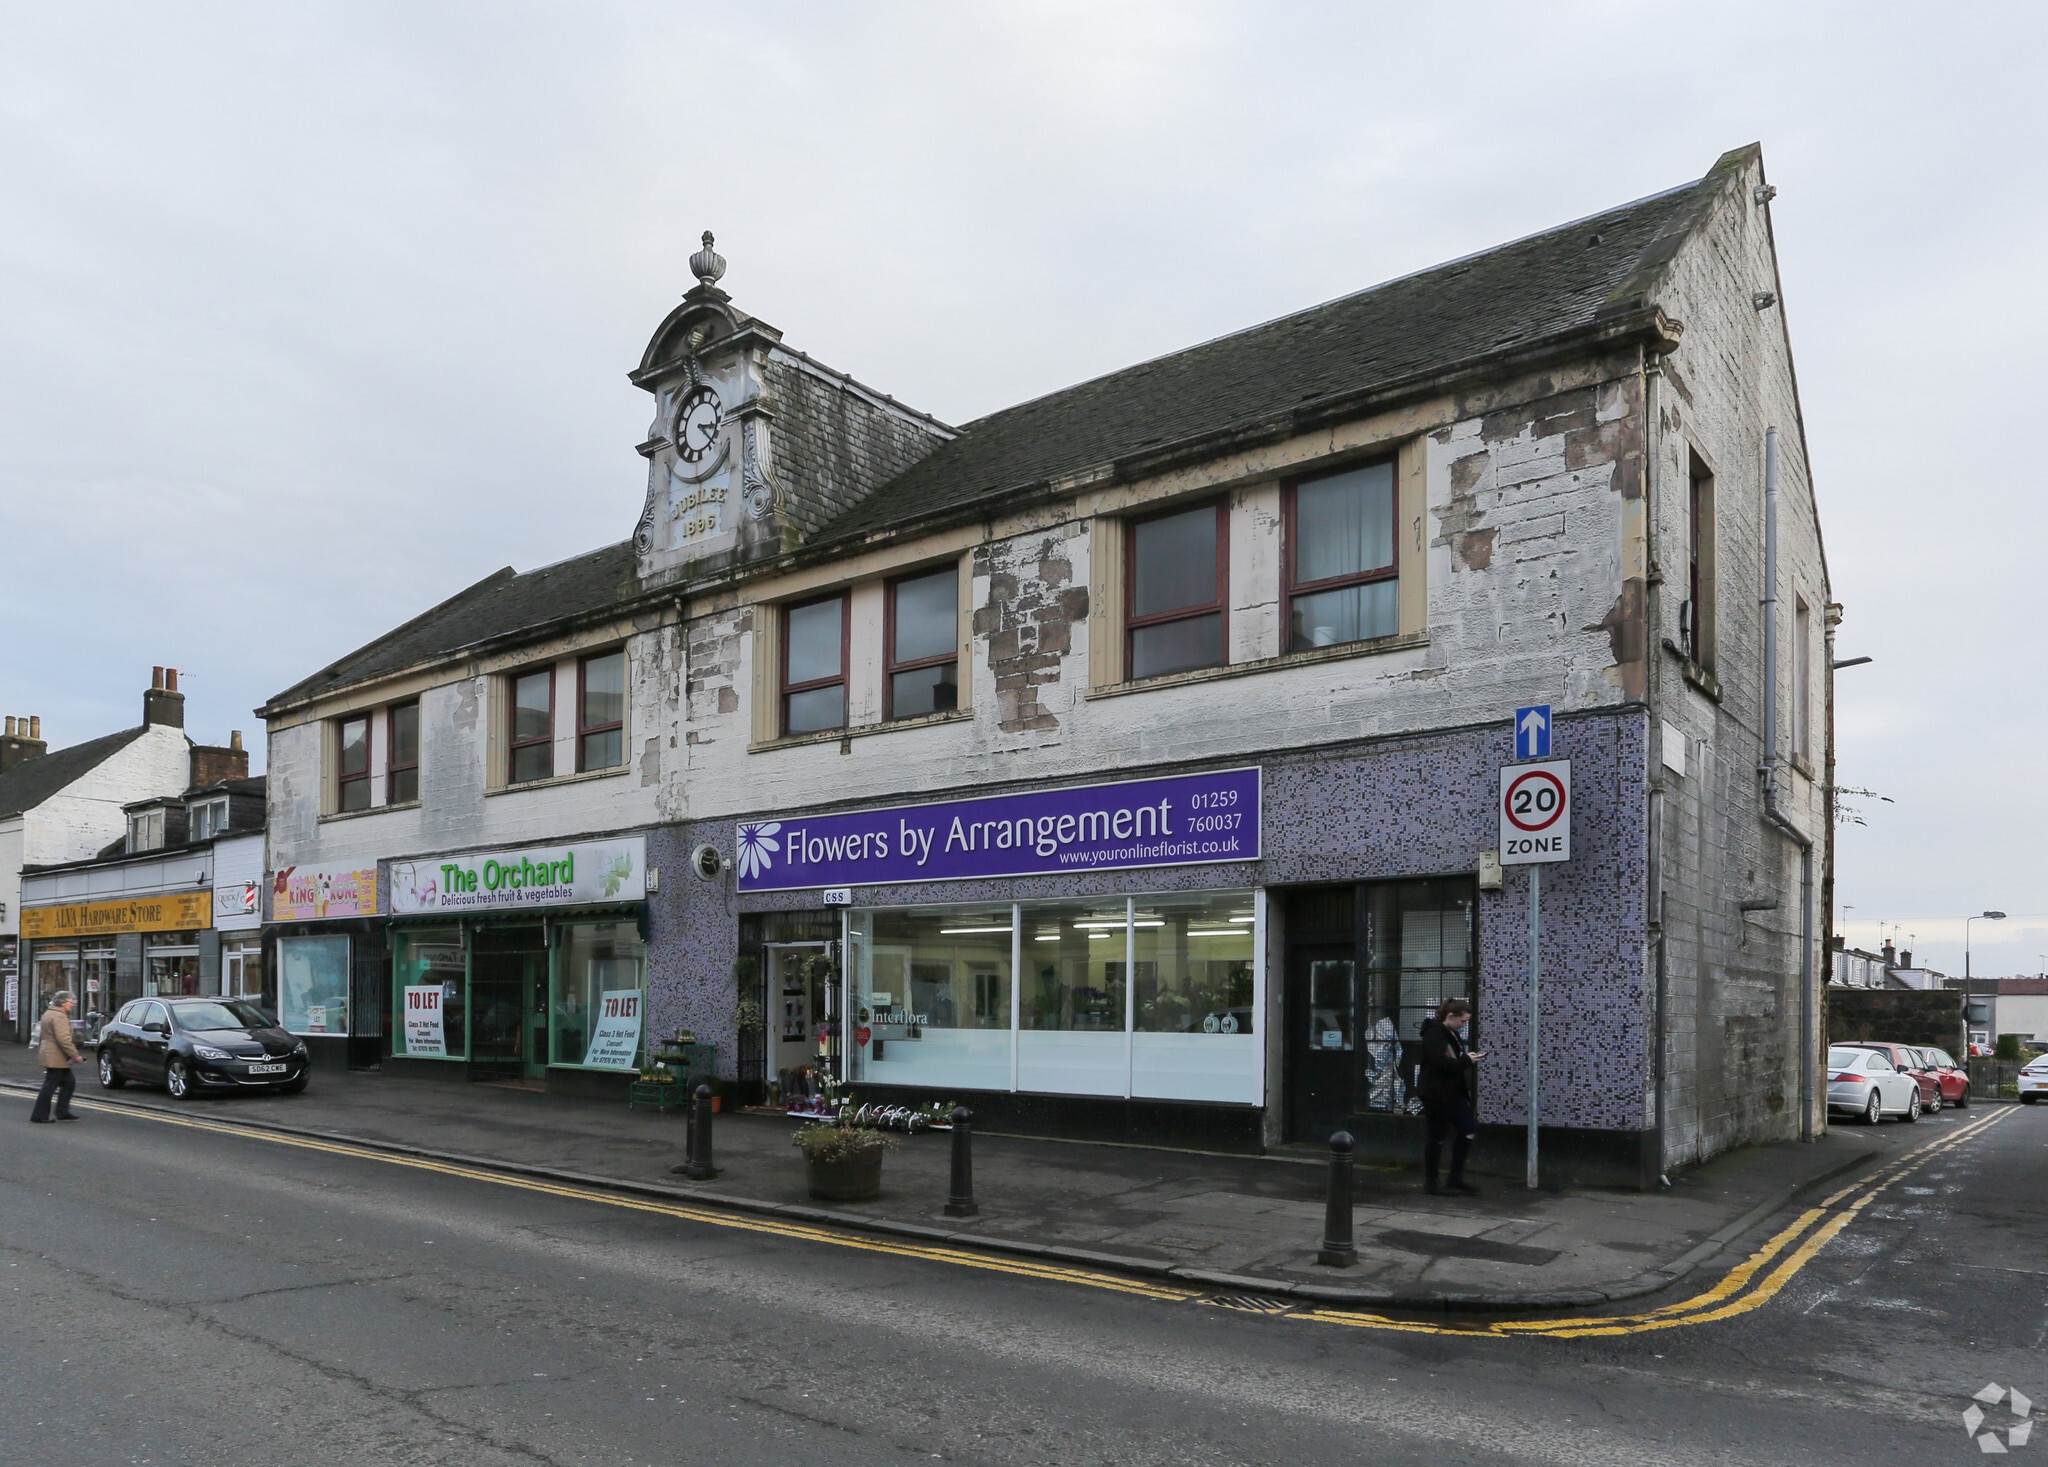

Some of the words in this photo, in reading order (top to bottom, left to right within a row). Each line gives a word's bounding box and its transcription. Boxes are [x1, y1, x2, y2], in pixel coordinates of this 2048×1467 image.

[672, 488, 728, 519] JUBILEE
[1191, 790, 1238, 810] 01259
[1514, 787, 1556, 815] 20
[787, 828, 889, 865] Flowers
[900, 818, 935, 866] by
[945, 797, 1173, 857] Arrangement
[1187, 813, 1242, 833] 760037
[1059, 836, 1240, 866] www.youronlineflorist.co.uk
[1507, 836, 1562, 855] ZONE
[440, 863, 477, 893] The
[483, 851, 574, 890] Orchard
[441, 894, 476, 906] Delicious
[477, 891, 497, 903] fresh
[498, 889, 515, 902] fruit
[516, 889, 523, 901] &
[525, 885, 573, 902] vegetables
[825, 892, 844, 903] CSS
[54, 907, 78, 928] ALVA
[80, 906, 128, 927] HARDWARE
[129, 901, 162, 924] STORE
[408, 992, 420, 1009] TO
[423, 992, 439, 1009] LET
[605, 998, 619, 1017] TO
[620, 997, 638, 1017] LET
[871, 1008, 928, 1025] Interflora
[599, 1029, 611, 1038] Class
[616, 1030, 624, 1038] Hot
[624, 1030, 635, 1038] Food
